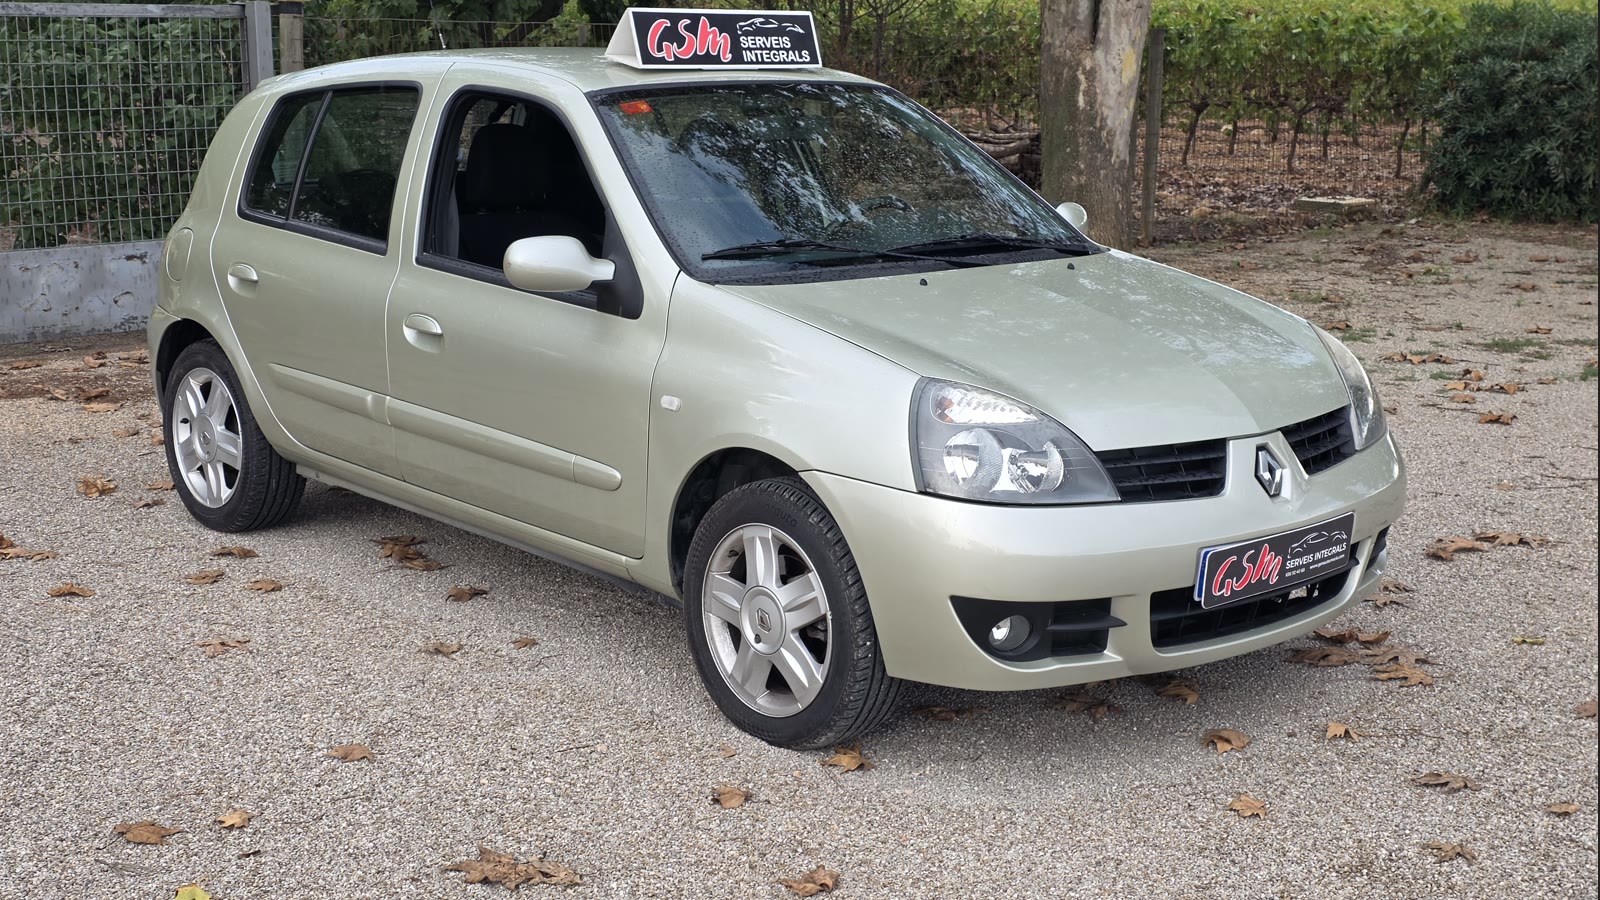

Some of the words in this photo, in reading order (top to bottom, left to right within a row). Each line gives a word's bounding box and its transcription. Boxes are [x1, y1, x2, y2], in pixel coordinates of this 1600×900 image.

[740, 36, 791, 49] SERVEIS
[743, 50, 811, 62] INTEGRALS
[1285, 553, 1314, 569] SERVEIS
[1314, 542, 1347, 561] INTEGRALS
